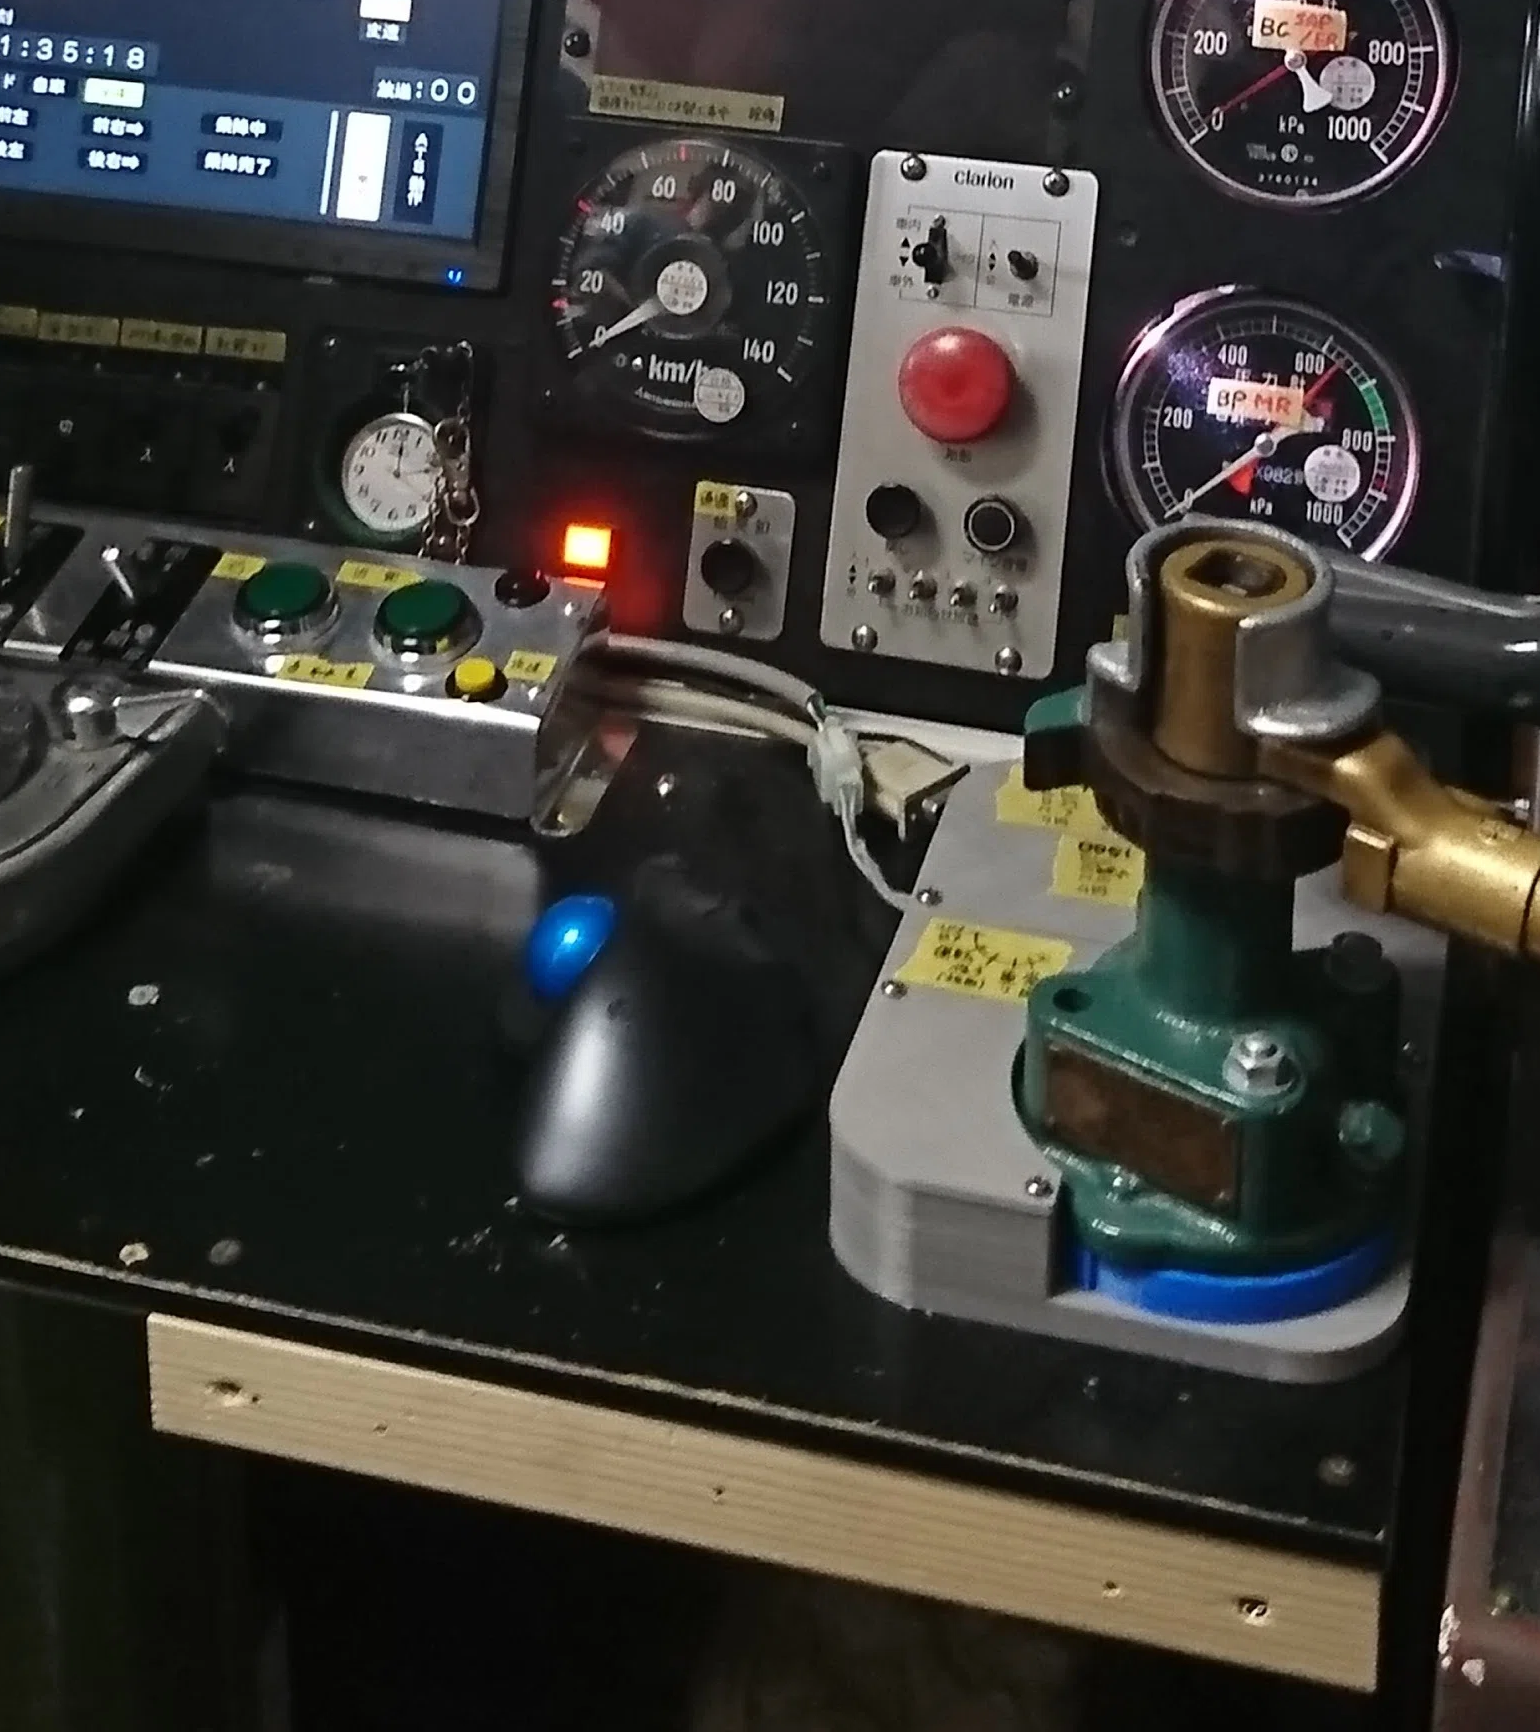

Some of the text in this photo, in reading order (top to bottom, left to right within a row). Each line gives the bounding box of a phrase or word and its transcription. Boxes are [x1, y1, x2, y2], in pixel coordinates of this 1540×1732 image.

[1260, 17, 1291, 39] BC
[1193, 29, 1228, 56] 200
[1368, 40, 1405, 66] 800
[1211, 106, 1225, 132] 0
[1278, 116, 1305, 136] kPa
[1327, 116, 1372, 142] 1000
[651, 175, 676, 200] 60
[711, 179, 736, 204] 80
[600, 211, 625, 235] 40
[752, 220, 784, 247] 100
[579, 270, 604, 294] 20
[765, 279, 799, 306] 120
[742, 338, 776, 364] 140
[1217, 344, 1248, 366] 400
[1295, 352, 1326, 374] 600
[1217, 390, 1247, 408] BP
[1163, 406, 1193, 429] 200
[1341, 428, 1373, 452] 800
[1249, 498, 1273, 515] kPa
[1306, 500, 1344, 525] 1000
